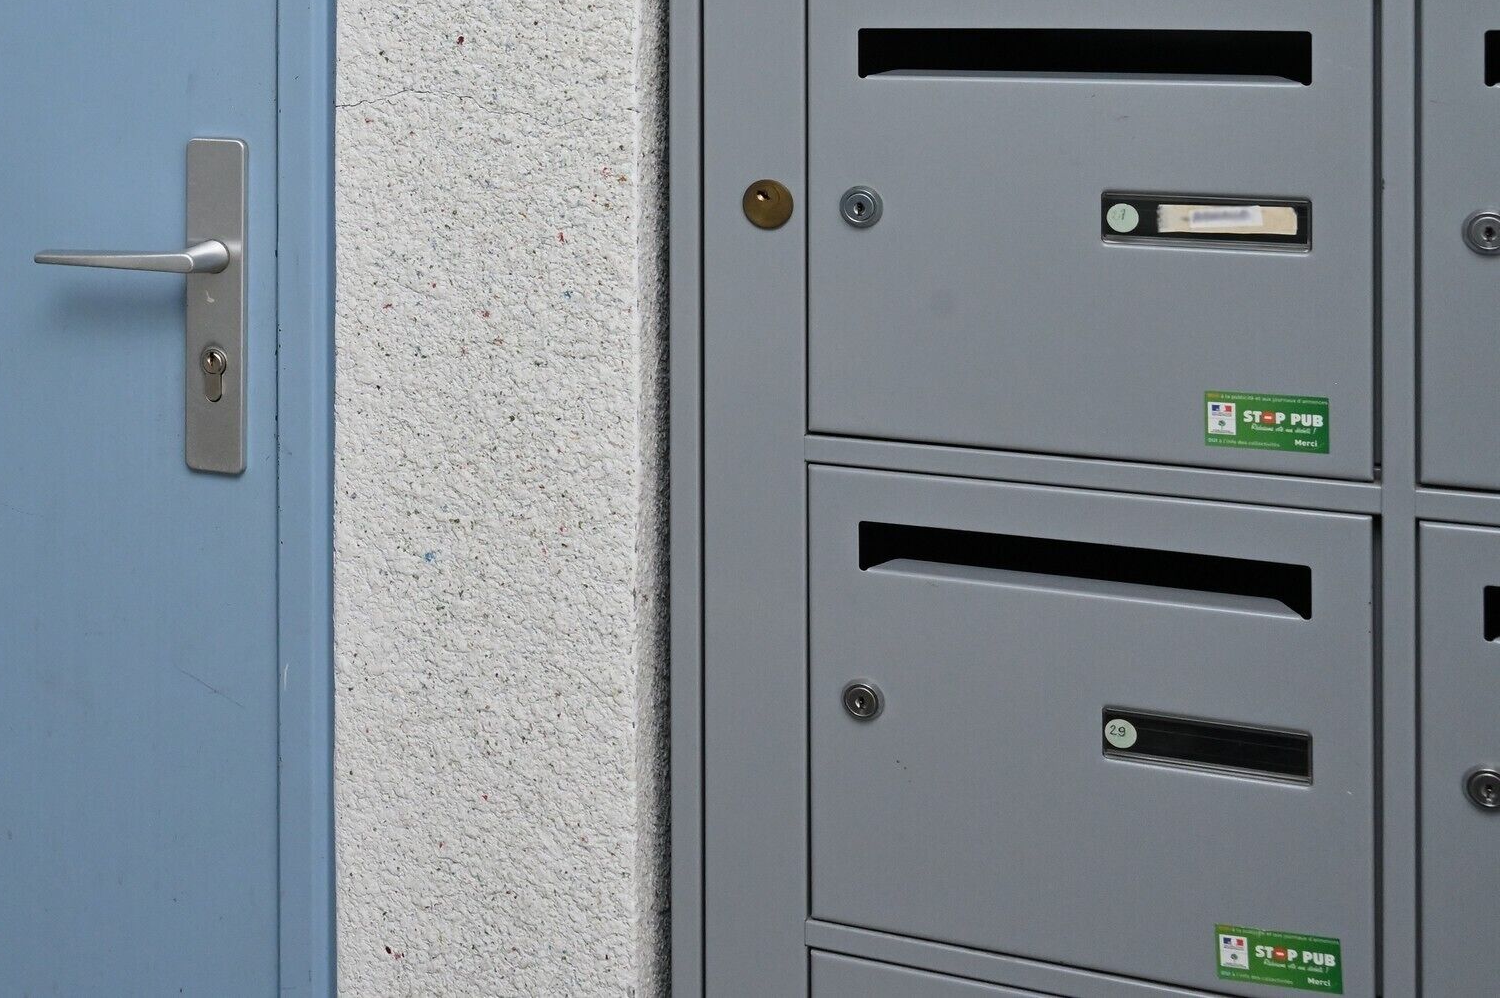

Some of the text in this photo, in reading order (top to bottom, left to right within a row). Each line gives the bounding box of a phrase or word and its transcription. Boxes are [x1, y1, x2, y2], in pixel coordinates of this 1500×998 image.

[1243, 409, 1324, 427] STOP PUB
[1294, 439, 1318, 447] Merci
[1110, 724, 1126, 737] 29
[1255, 945, 1298, 962] STOP
[1302, 951, 1336, 967] PUB
[1306, 977, 1332, 987] Merci
